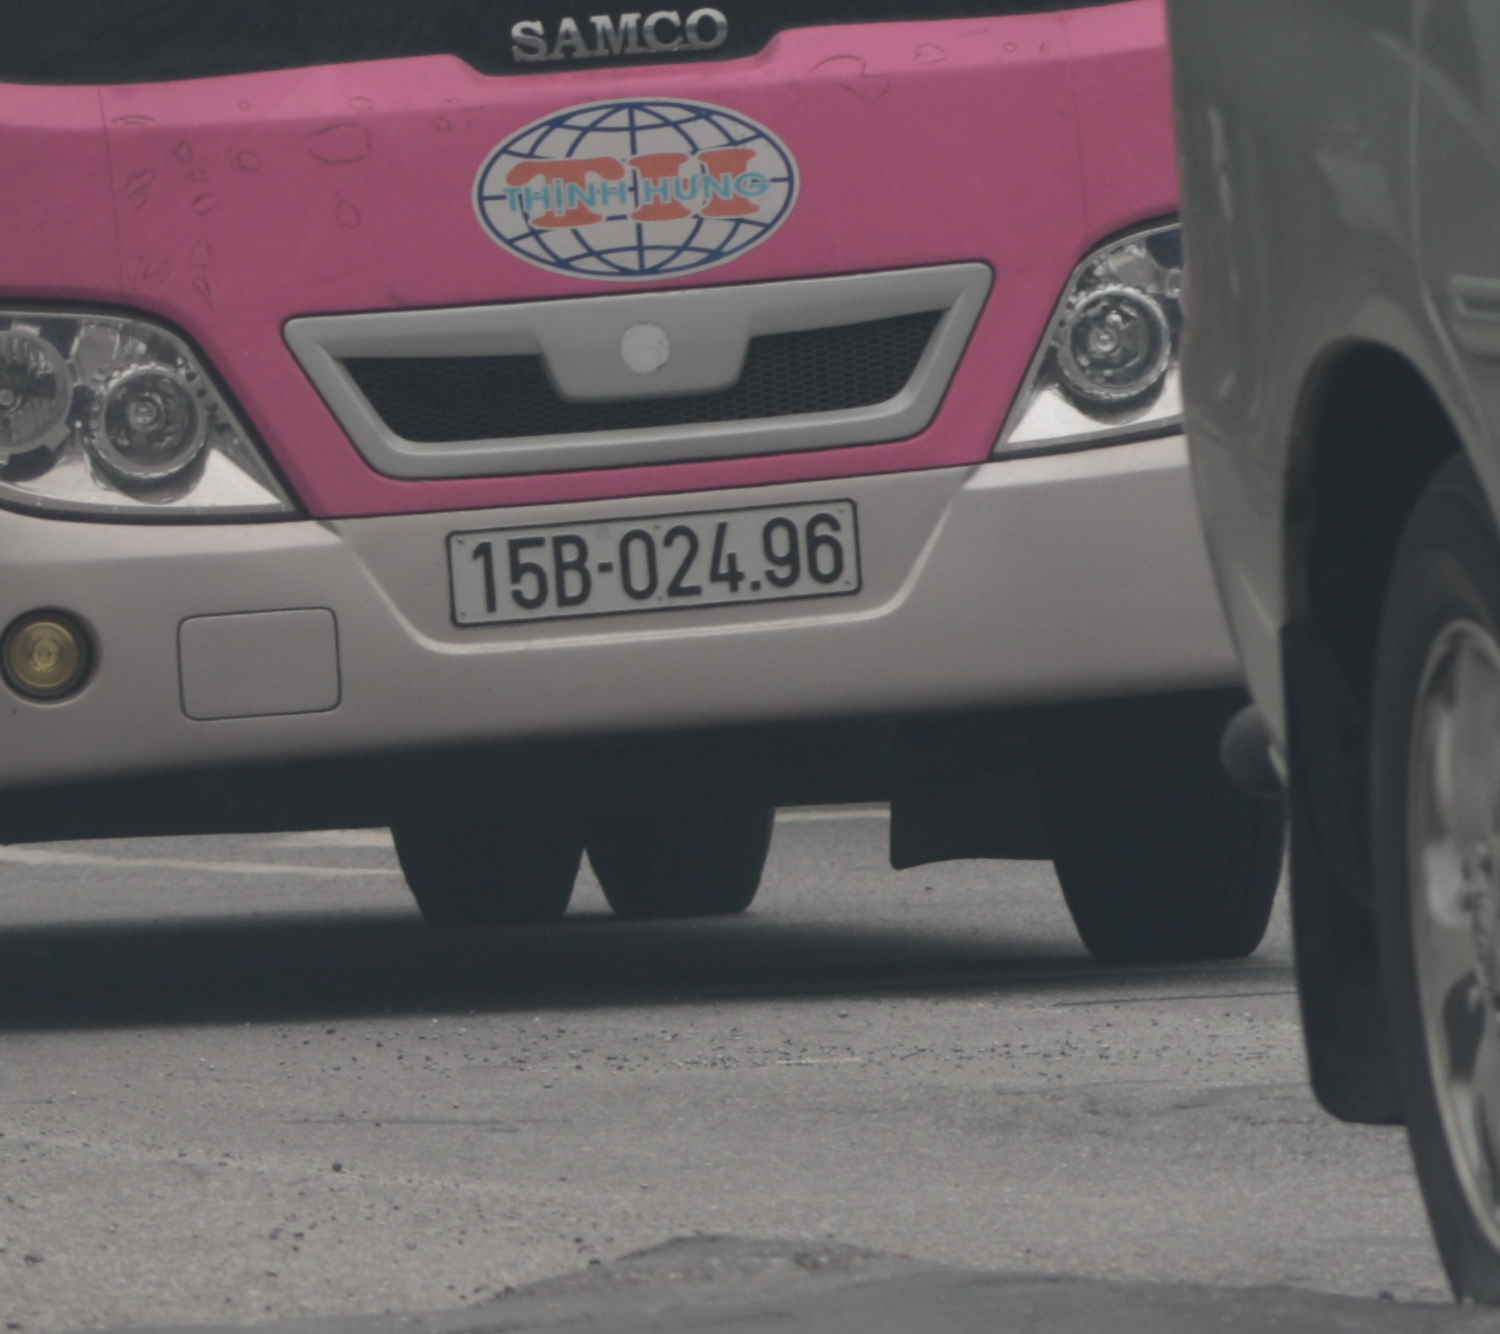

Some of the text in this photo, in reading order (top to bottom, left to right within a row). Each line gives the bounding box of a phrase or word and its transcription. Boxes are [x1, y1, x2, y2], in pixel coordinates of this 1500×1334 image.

[511, 7, 729, 63] SAMCO
[502, 178, 628, 216] THỊNH
[470, 511, 846, 615] 15B-024.96
